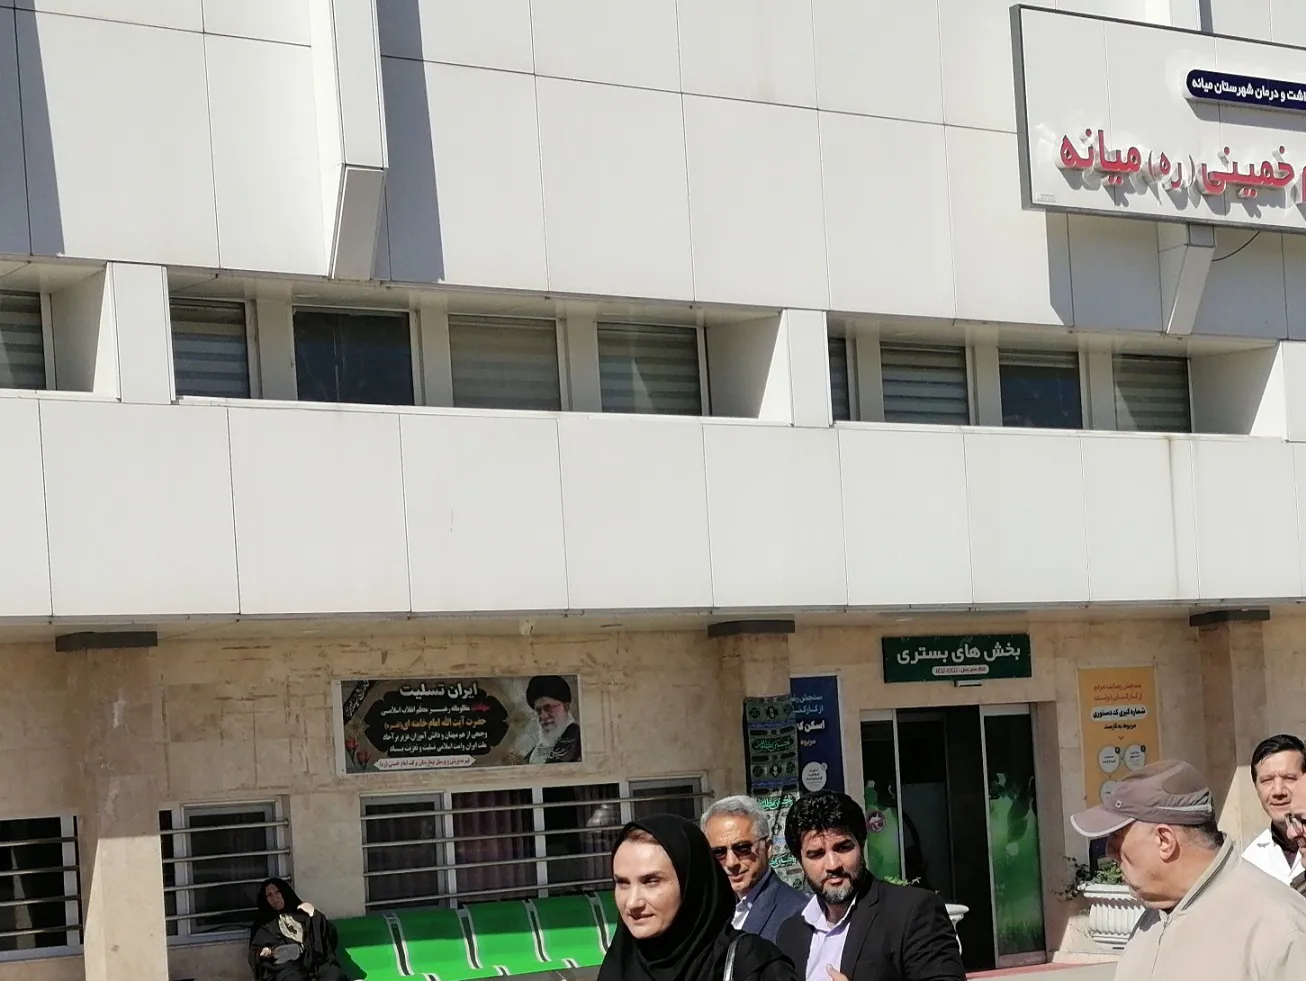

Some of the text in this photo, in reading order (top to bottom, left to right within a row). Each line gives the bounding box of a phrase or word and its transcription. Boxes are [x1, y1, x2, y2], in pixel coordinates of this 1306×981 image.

[1191, 77, 1214, 93] میانه
[1214, 79, 1254, 98] شهرستان
[1255, 85, 1279, 101] درمان
[1280, 91, 1287, 103] و
[1060, 128, 1142, 185] میانه
[1201, 145, 1295, 198] خمینی
[896, 641, 1021, 664] بخش های بستری
[400, 682, 478, 700] ایران تسلیت
[380, 705, 401, 716] اسلامی
[1092, 709, 1113, 719] دستوری
[1119, 708, 1130, 717] گیری
[1131, 707, 1146, 716] شماره
[411, 716, 428, 727] خامنه
[428, 717, 440, 730] امام
[465, 716, 487, 728] حضرت
[804, 719, 826, 732] اسکن
[466, 730, 471, 739] از
